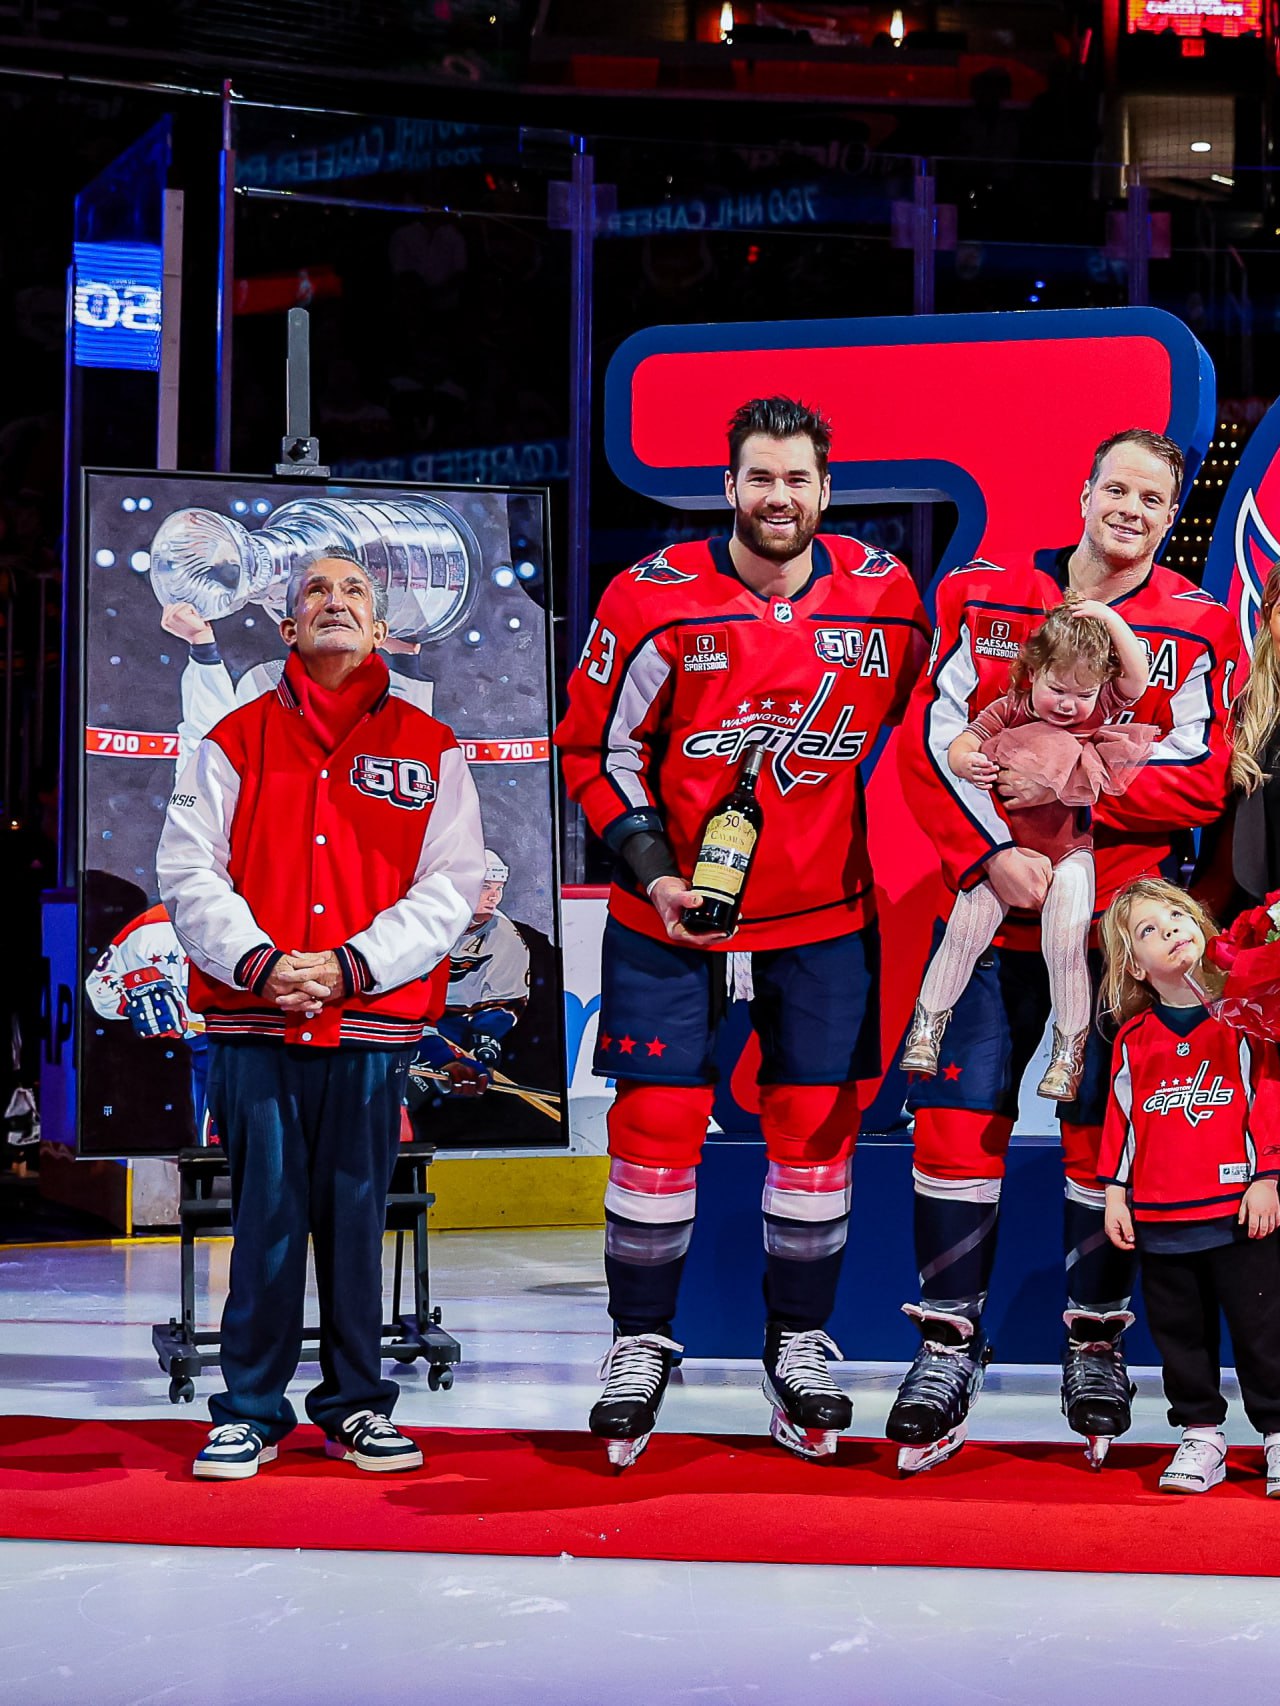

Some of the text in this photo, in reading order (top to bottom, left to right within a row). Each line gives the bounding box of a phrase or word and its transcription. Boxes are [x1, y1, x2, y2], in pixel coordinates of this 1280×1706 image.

[816, 628, 889, 677] 50 A
[975, 646, 1019, 659] SPORTSBOOK
[976, 637, 1019, 651] CAESARS
[684, 652, 727, 663] CAESARS
[684, 661, 728, 672] SPORTSBOOK
[1147, 639, 1177, 690] A
[721, 713, 798, 728] WASHINGTON
[97, 733, 140, 753] 700
[683, 672, 867, 797] capitals
[498, 743, 533, 759] 700
[354, 754, 435, 806] 50
[723, 814, 740, 828] 50
[463, 934, 487, 955] A
[1143, 1061, 1235, 1127] capitals
